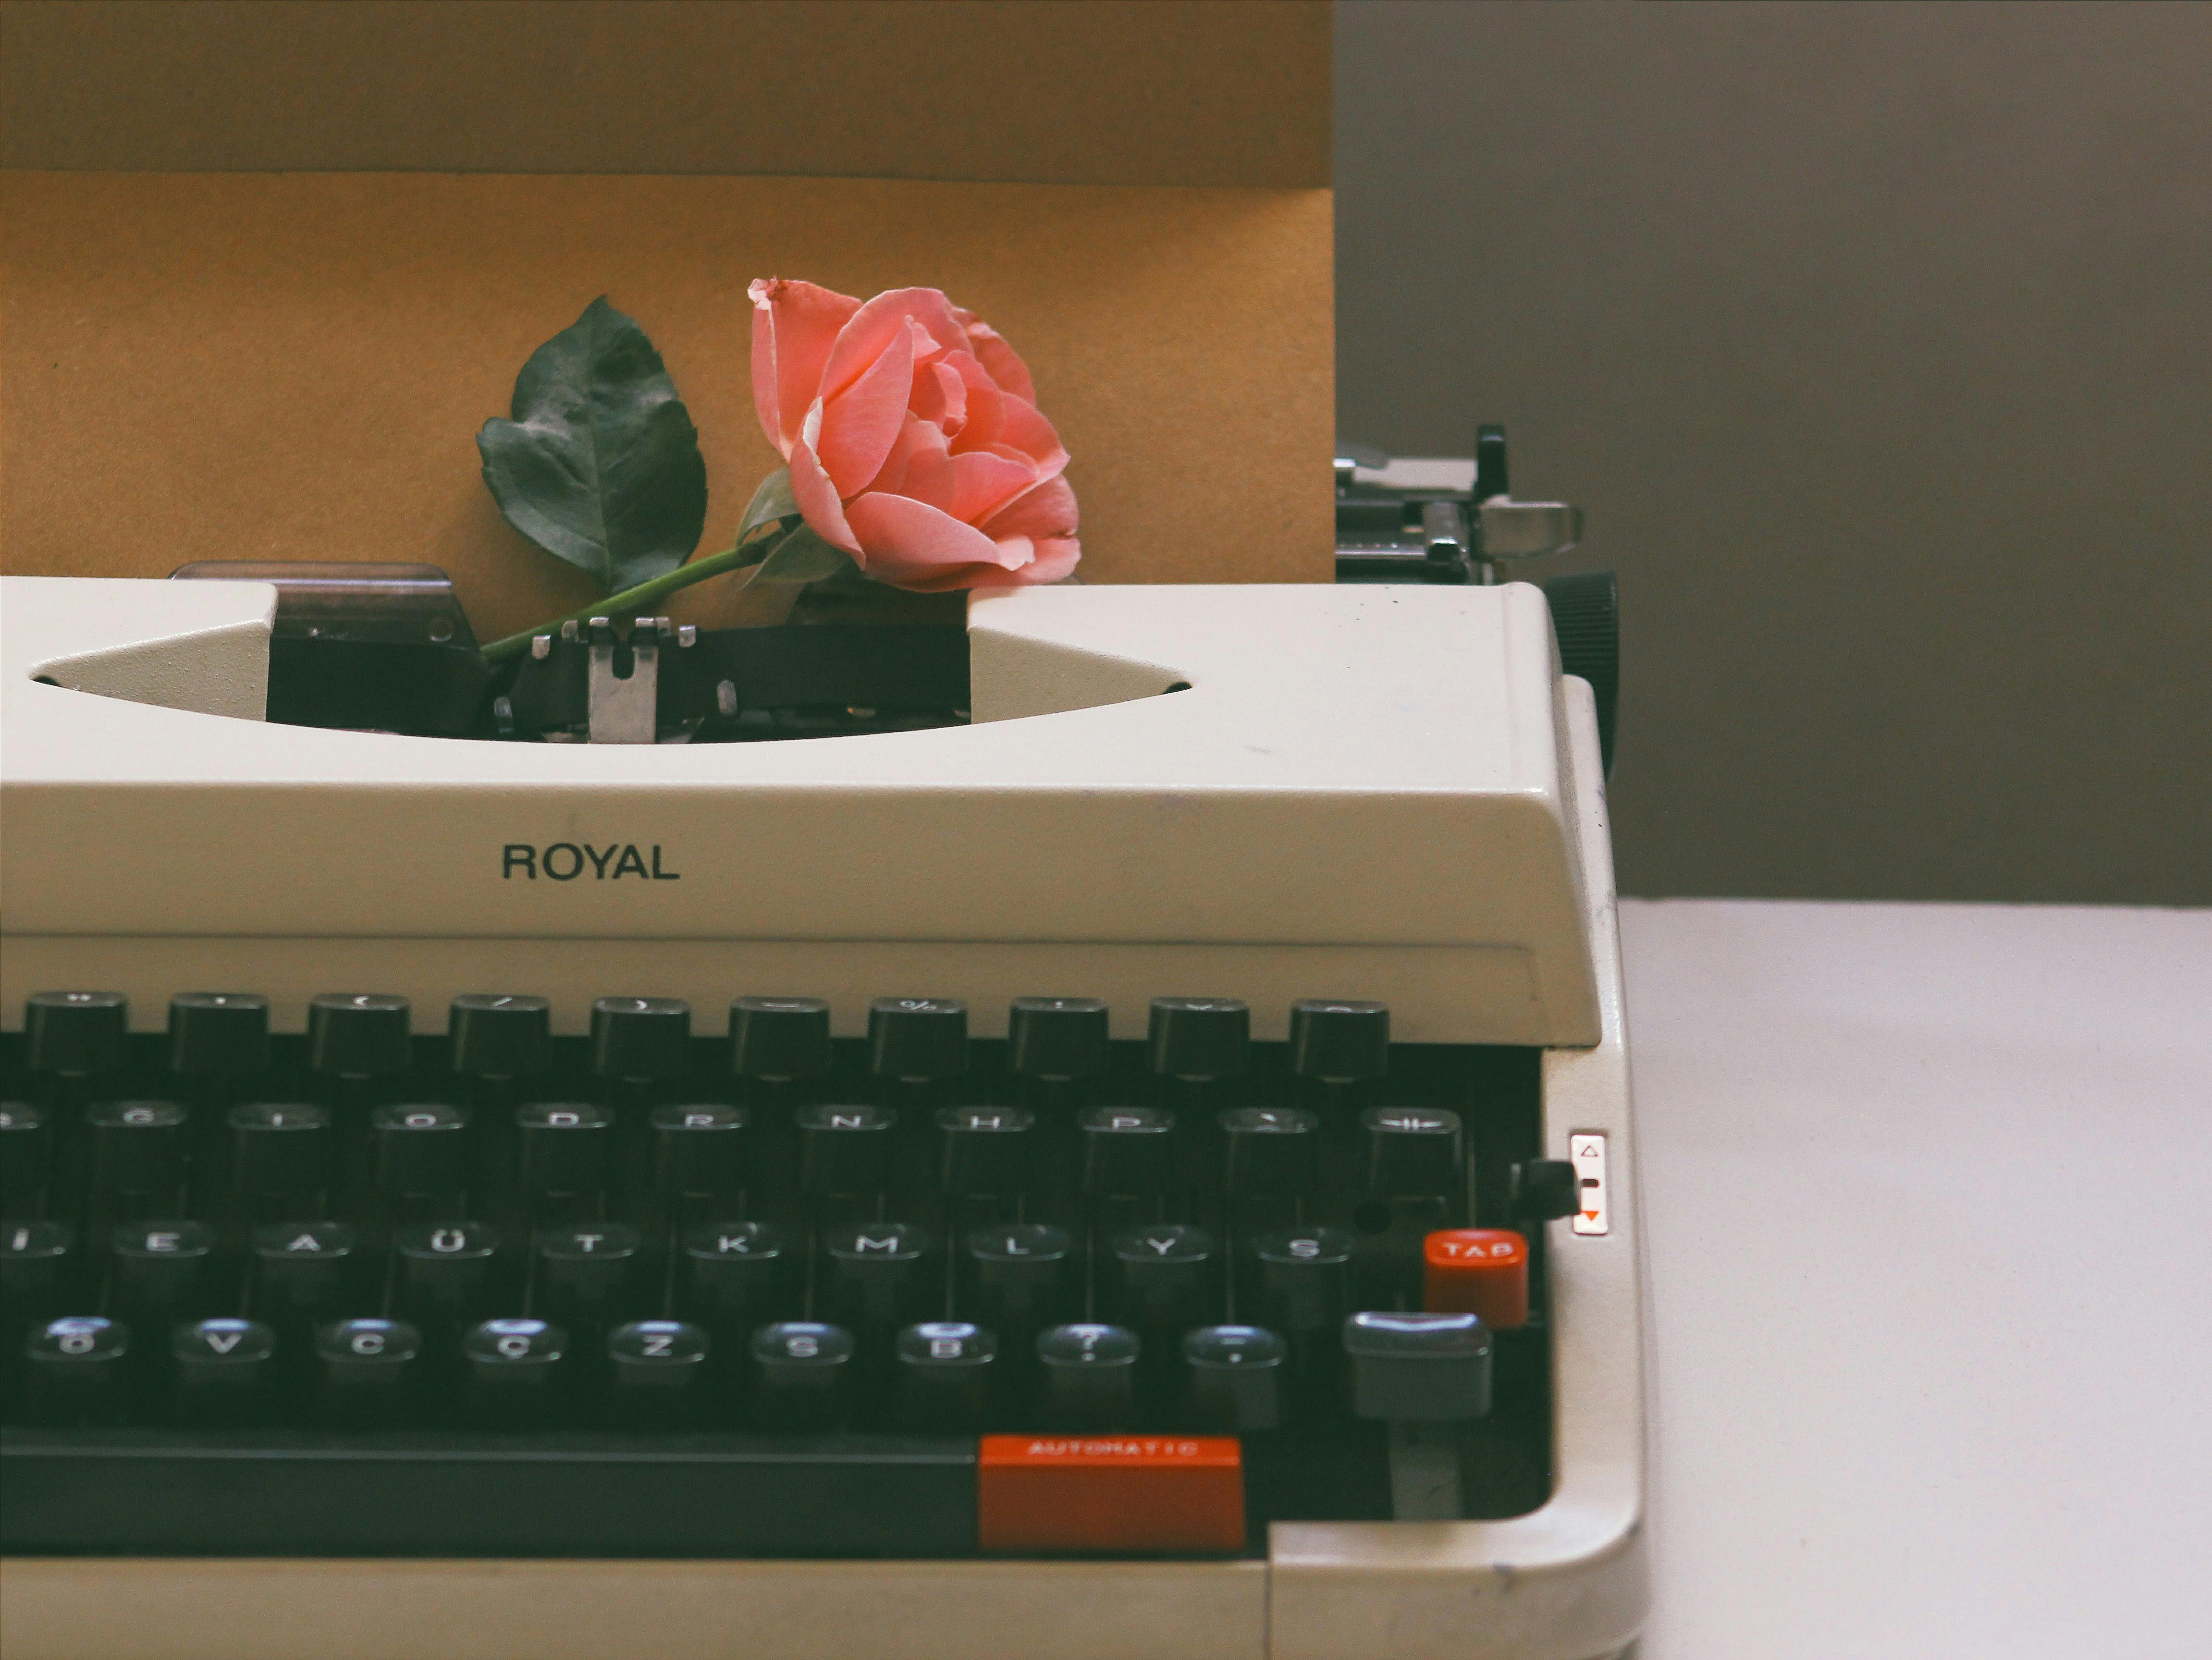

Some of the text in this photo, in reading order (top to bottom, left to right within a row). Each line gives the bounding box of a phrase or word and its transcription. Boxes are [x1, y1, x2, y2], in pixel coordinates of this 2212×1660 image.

[503, 843, 680, 880] ROYAL
[684, 1114, 714, 1127] R
[831, 1114, 861, 1127] N
[971, 1115, 1000, 1128] H
[1112, 1116, 1141, 1129] P
[146, 1232, 181, 1252] E
[287, 1233, 321, 1252] A
[574, 1233, 604, 1253] T
[718, 1234, 749, 1253] K
[855, 1234, 898, 1253] M
[1006, 1236, 1030, 1255] L
[1147, 1237, 1176, 1256] Y
[1443, 1242, 1514, 1258] TAB
[206, 1333, 242, 1354] V
[642, 1335, 674, 1356] Z
[786, 1336, 819, 1357] S
[1027, 1440, 1199, 1457] AUTOMATIC
